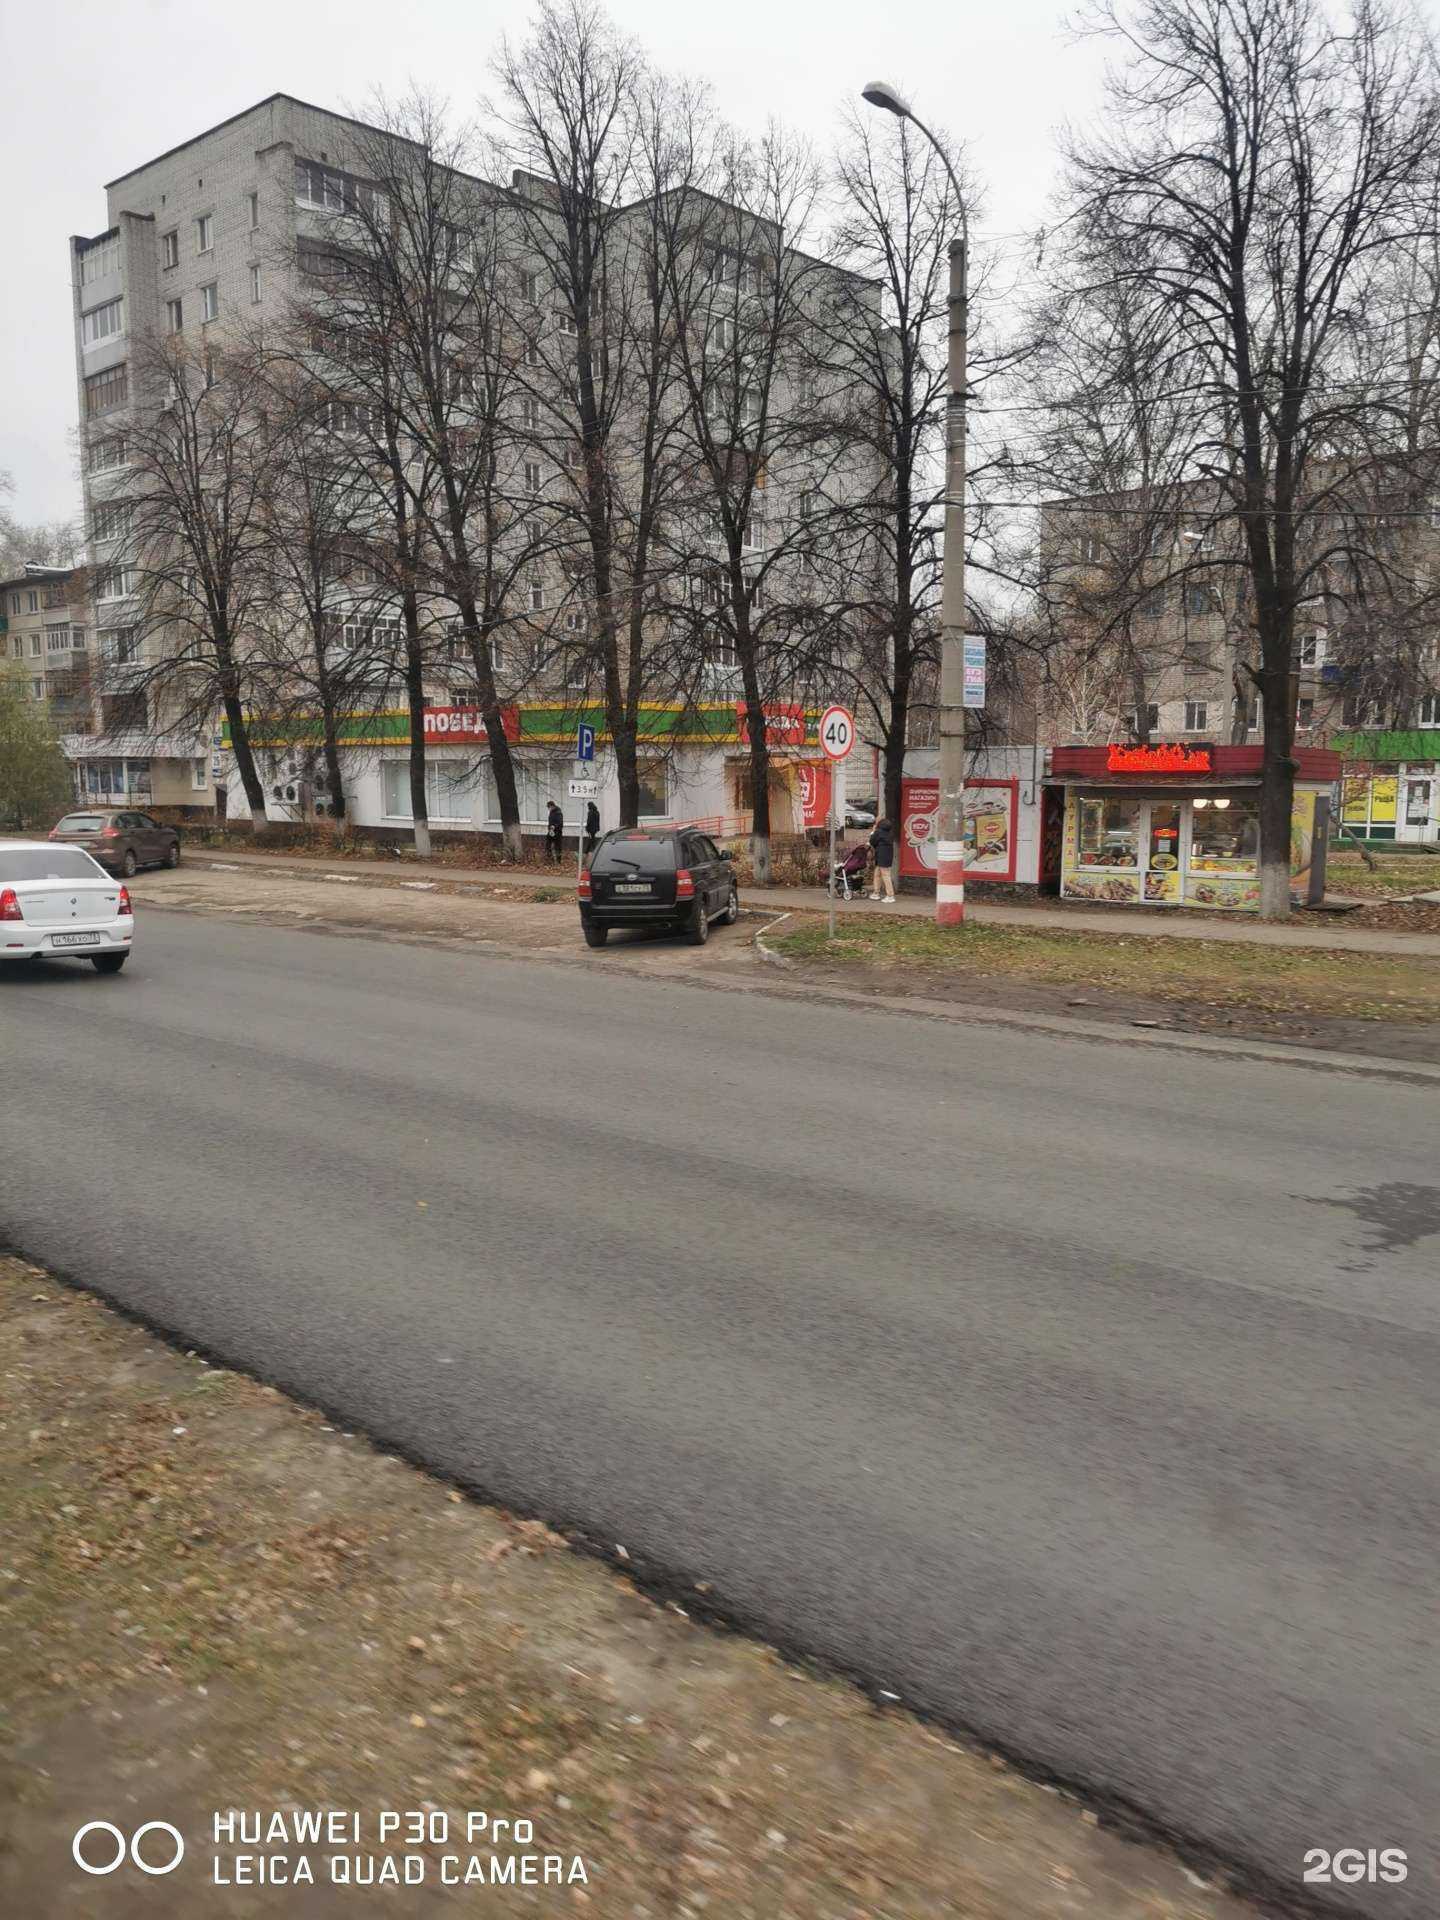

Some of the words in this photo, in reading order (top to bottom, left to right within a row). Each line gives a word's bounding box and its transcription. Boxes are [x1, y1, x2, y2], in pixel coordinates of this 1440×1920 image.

[423, 712, 505, 734] ПОБЕД
[825, 723, 848, 745] 40
[582, 728, 593, 757] P
